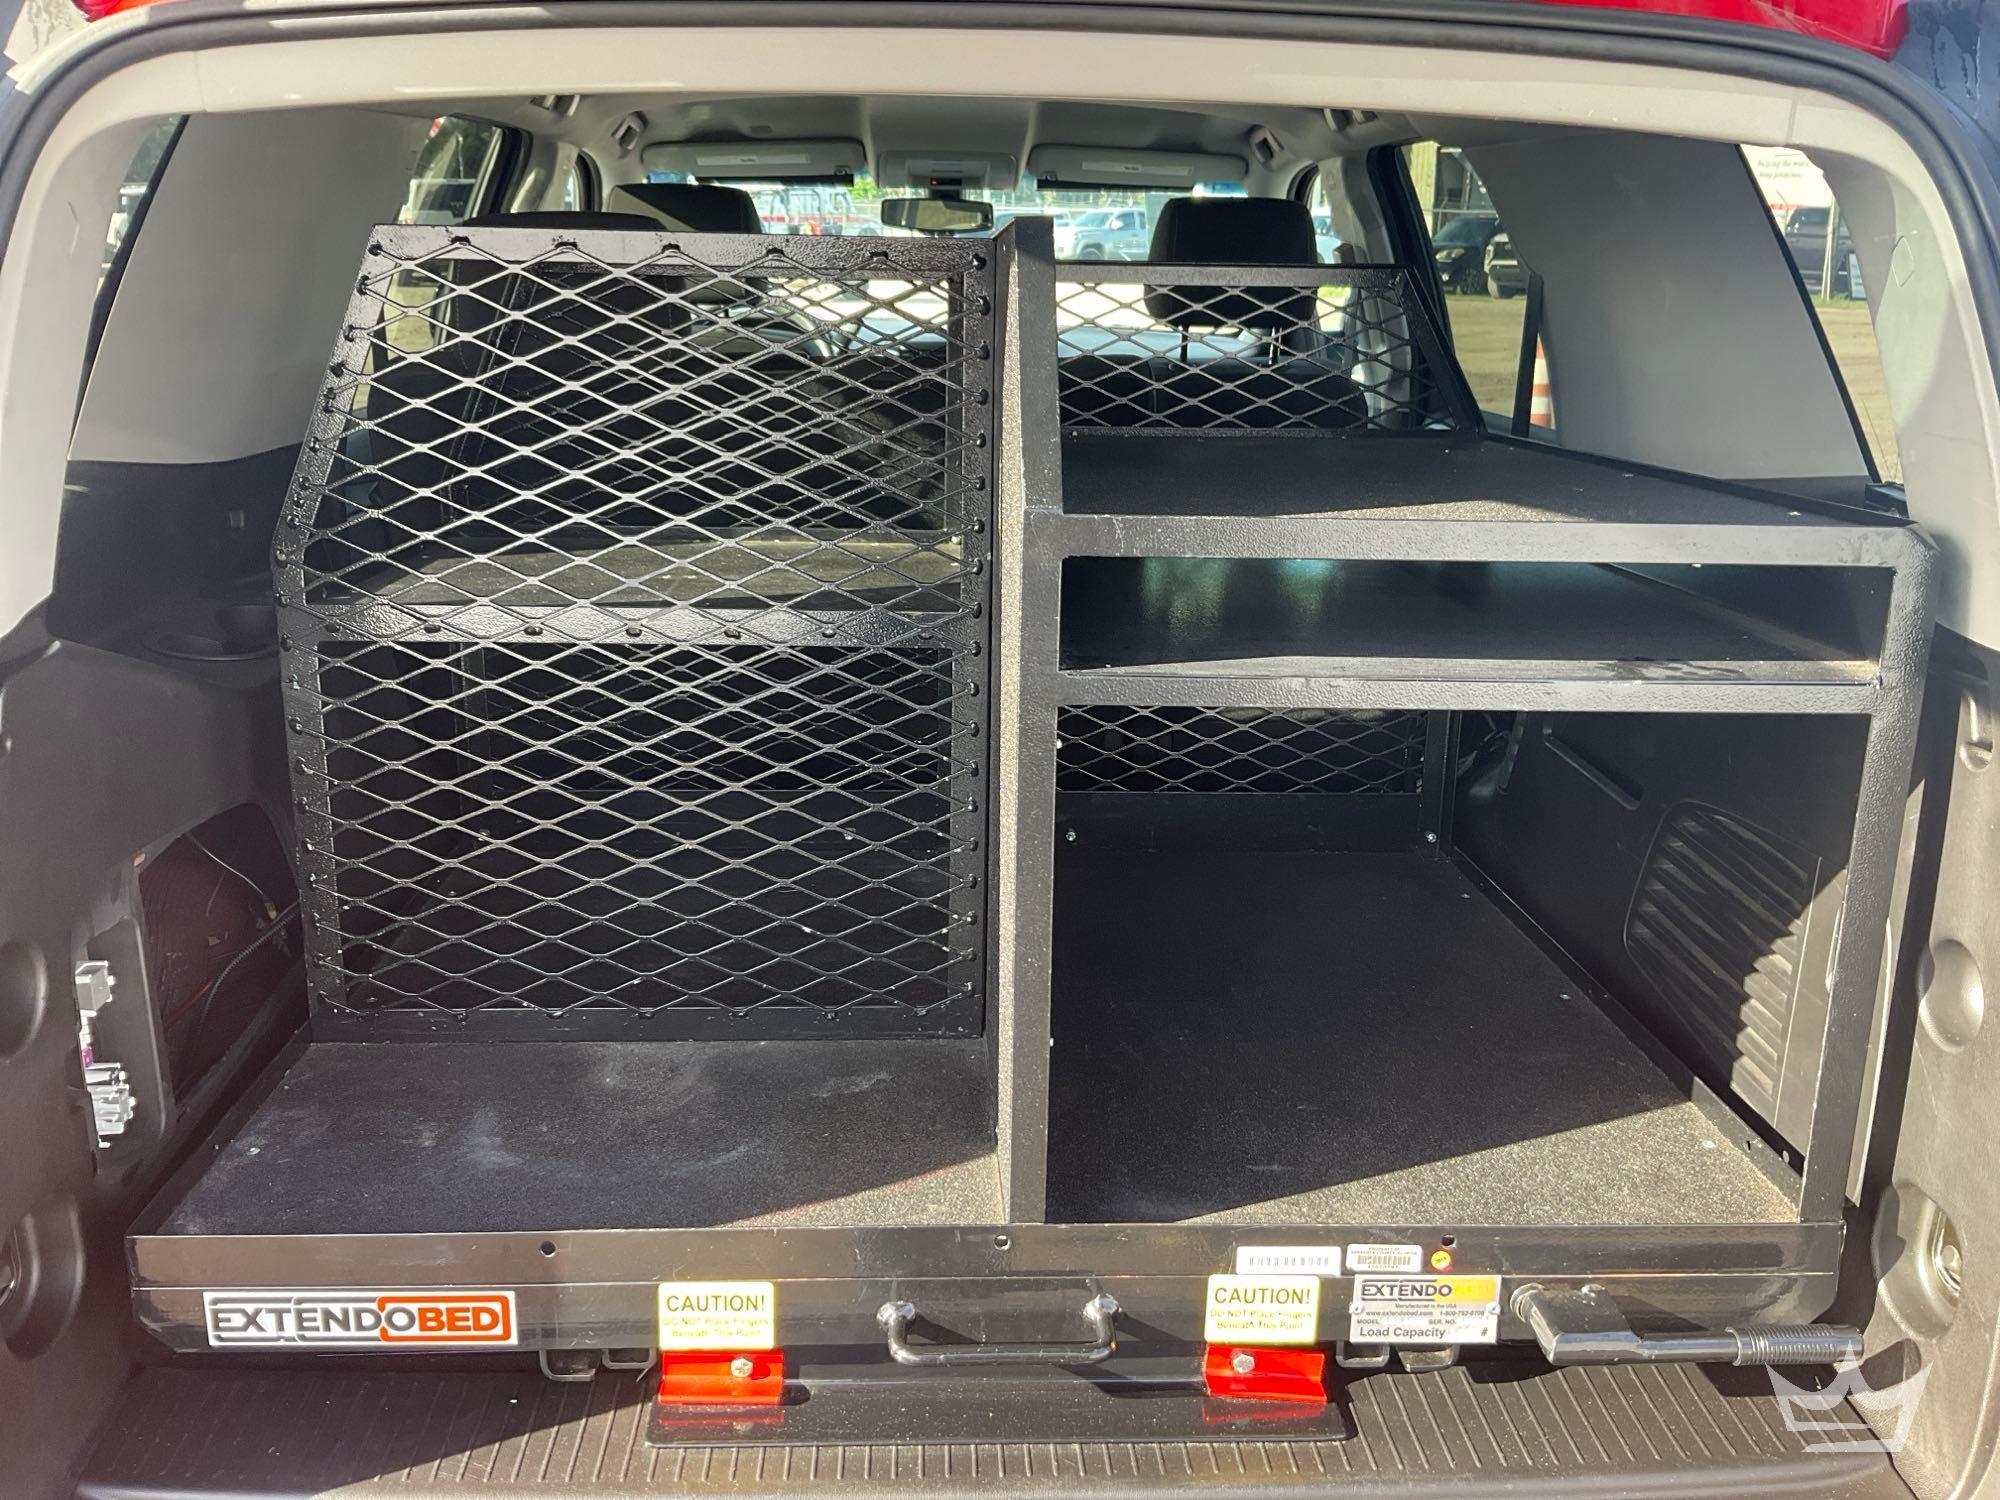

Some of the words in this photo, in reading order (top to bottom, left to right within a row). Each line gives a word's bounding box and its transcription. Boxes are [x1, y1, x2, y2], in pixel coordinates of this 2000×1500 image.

[666, 1294, 765, 1312] CAUTION!
[1215, 1287, 1311, 1305] CAUTION!
[211, 1306, 500, 1333] EXTENDOBED
[1359, 1326, 1390, 1337] Load
[1393, 1326, 1446, 1340] Capacity
